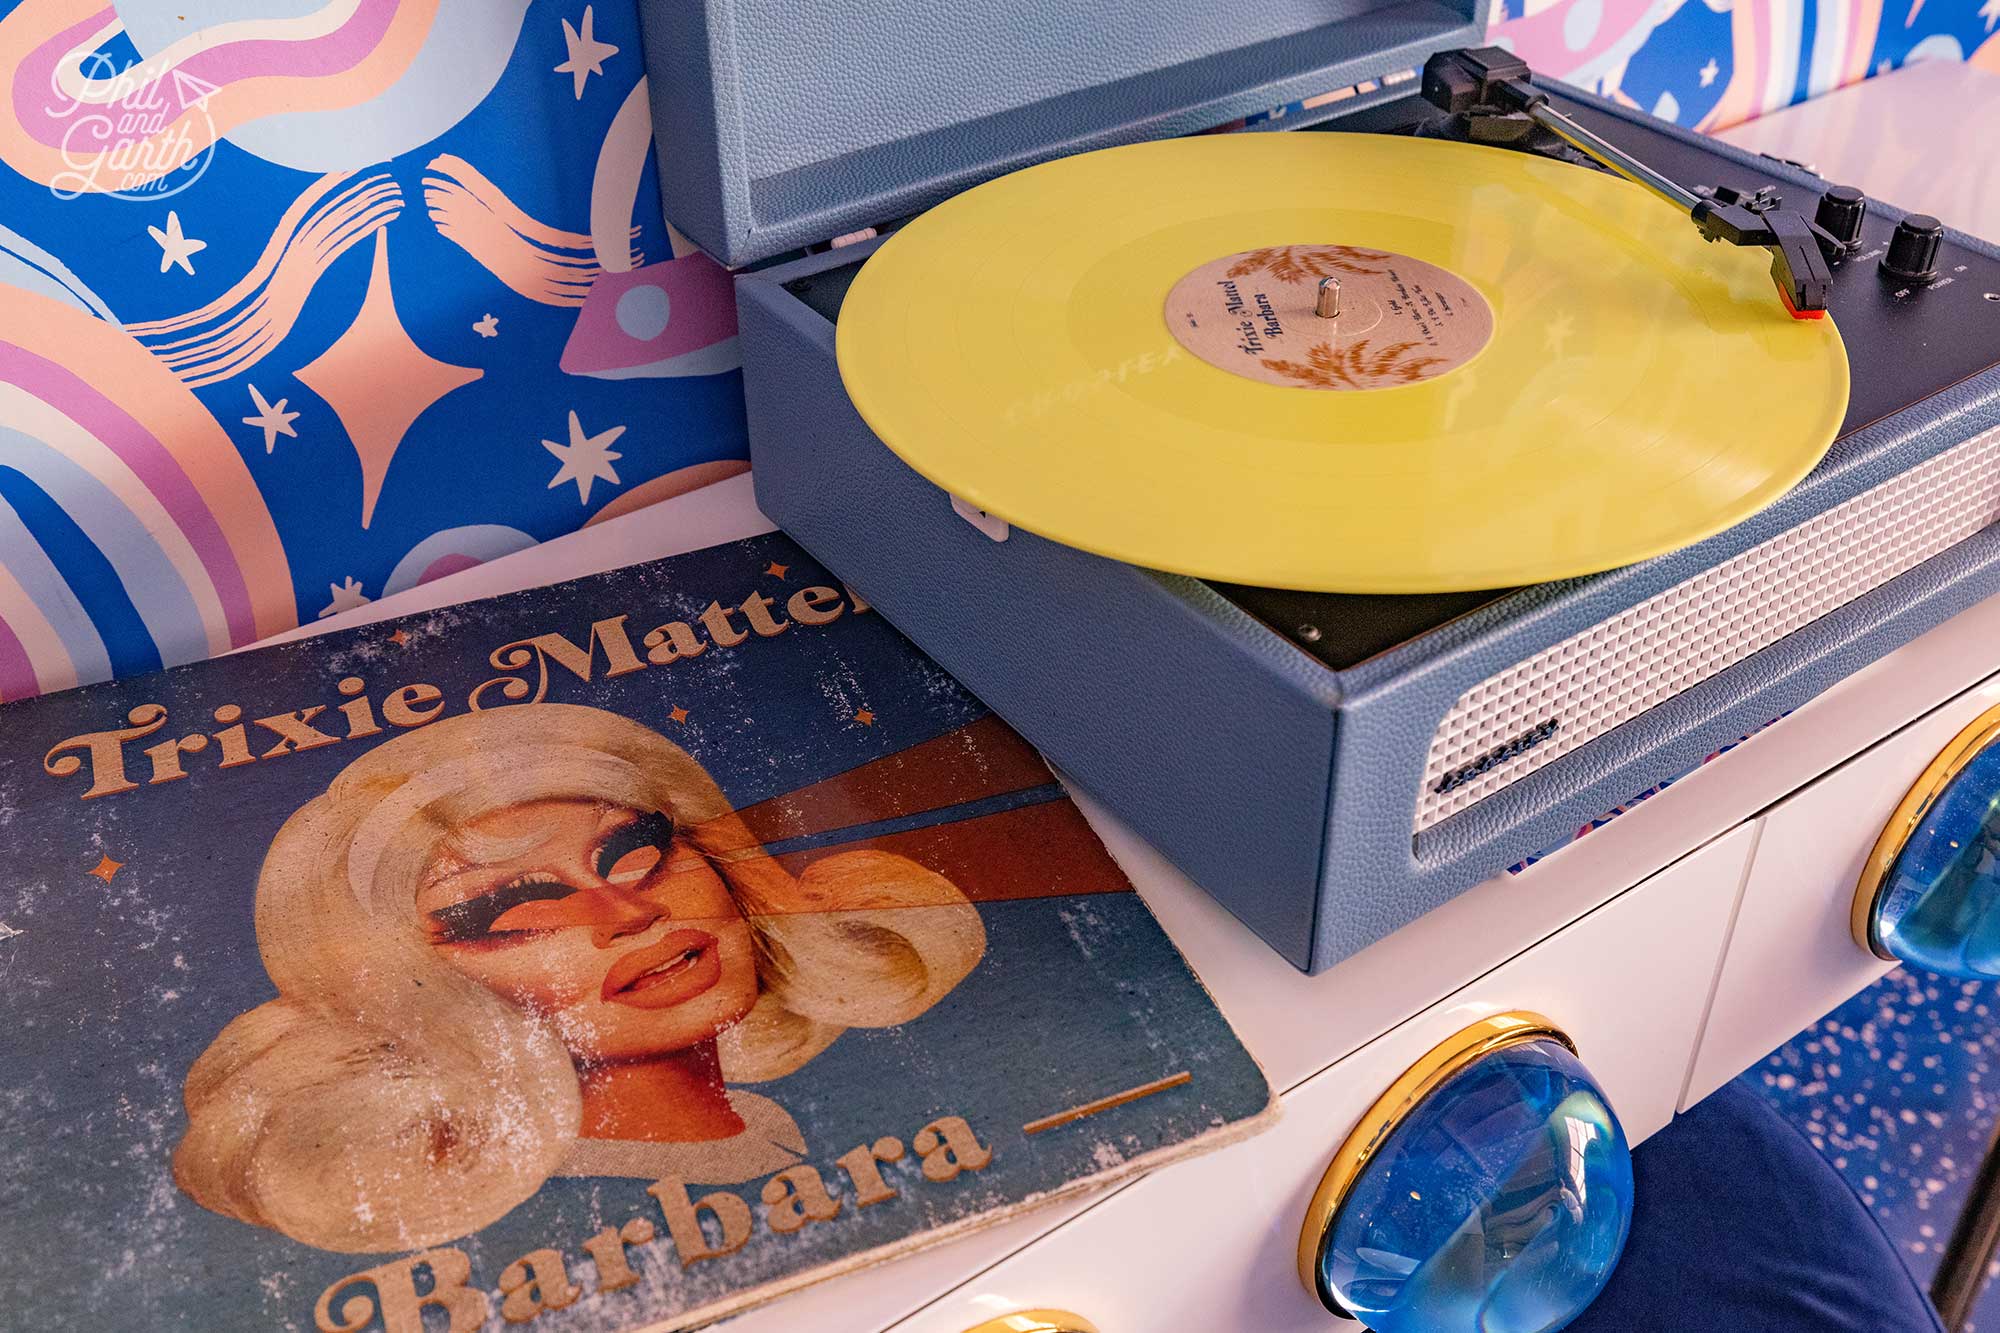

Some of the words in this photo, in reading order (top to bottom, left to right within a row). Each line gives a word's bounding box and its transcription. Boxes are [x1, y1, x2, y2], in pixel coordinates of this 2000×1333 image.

[1236, 320, 1265, 355] Trixie
[1254, 293, 1284, 339] Barbara
[43, 676, 446, 800] Trixie
[313, 1115, 993, 1333] Barbara
